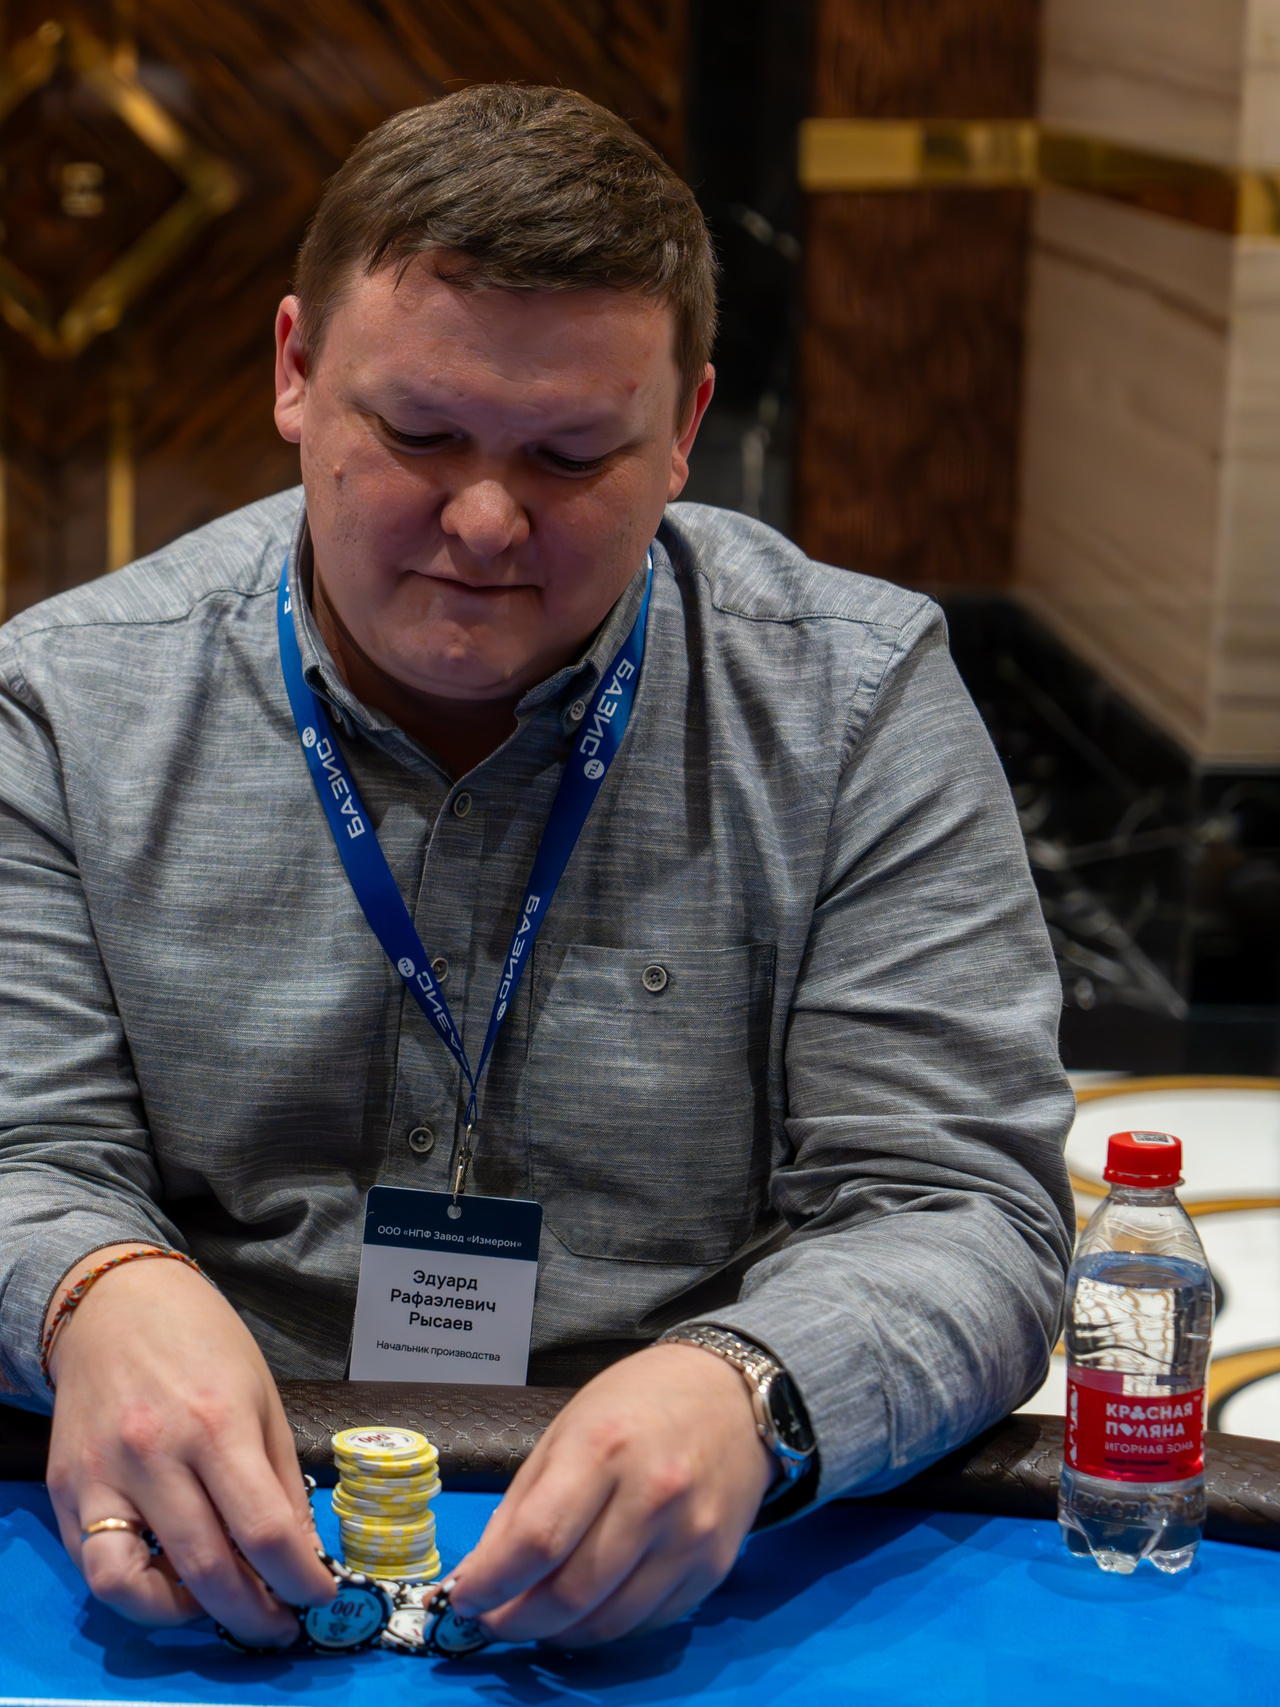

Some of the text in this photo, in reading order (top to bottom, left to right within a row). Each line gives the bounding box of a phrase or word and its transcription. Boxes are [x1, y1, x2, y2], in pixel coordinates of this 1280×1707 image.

[579, 658, 635, 757] БАЗИС
[316, 737, 366, 839] БАЗИС
[499, 894, 540, 1000] БАЗИС
[377, 1225, 522, 1249] ООО «НПФ Завод «Измерон»
[412, 1269, 478, 1292] Эдуард
[390, 1288, 496, 1313] Рафаэлевич
[409, 1311, 473, 1331] Рысаев
[376, 1340, 501, 1362] Начальник производства
[1104, 1440, 1194, 1454] ИГОРНАЯ ЗОНА
[331, 1600, 365, 1618] 100
